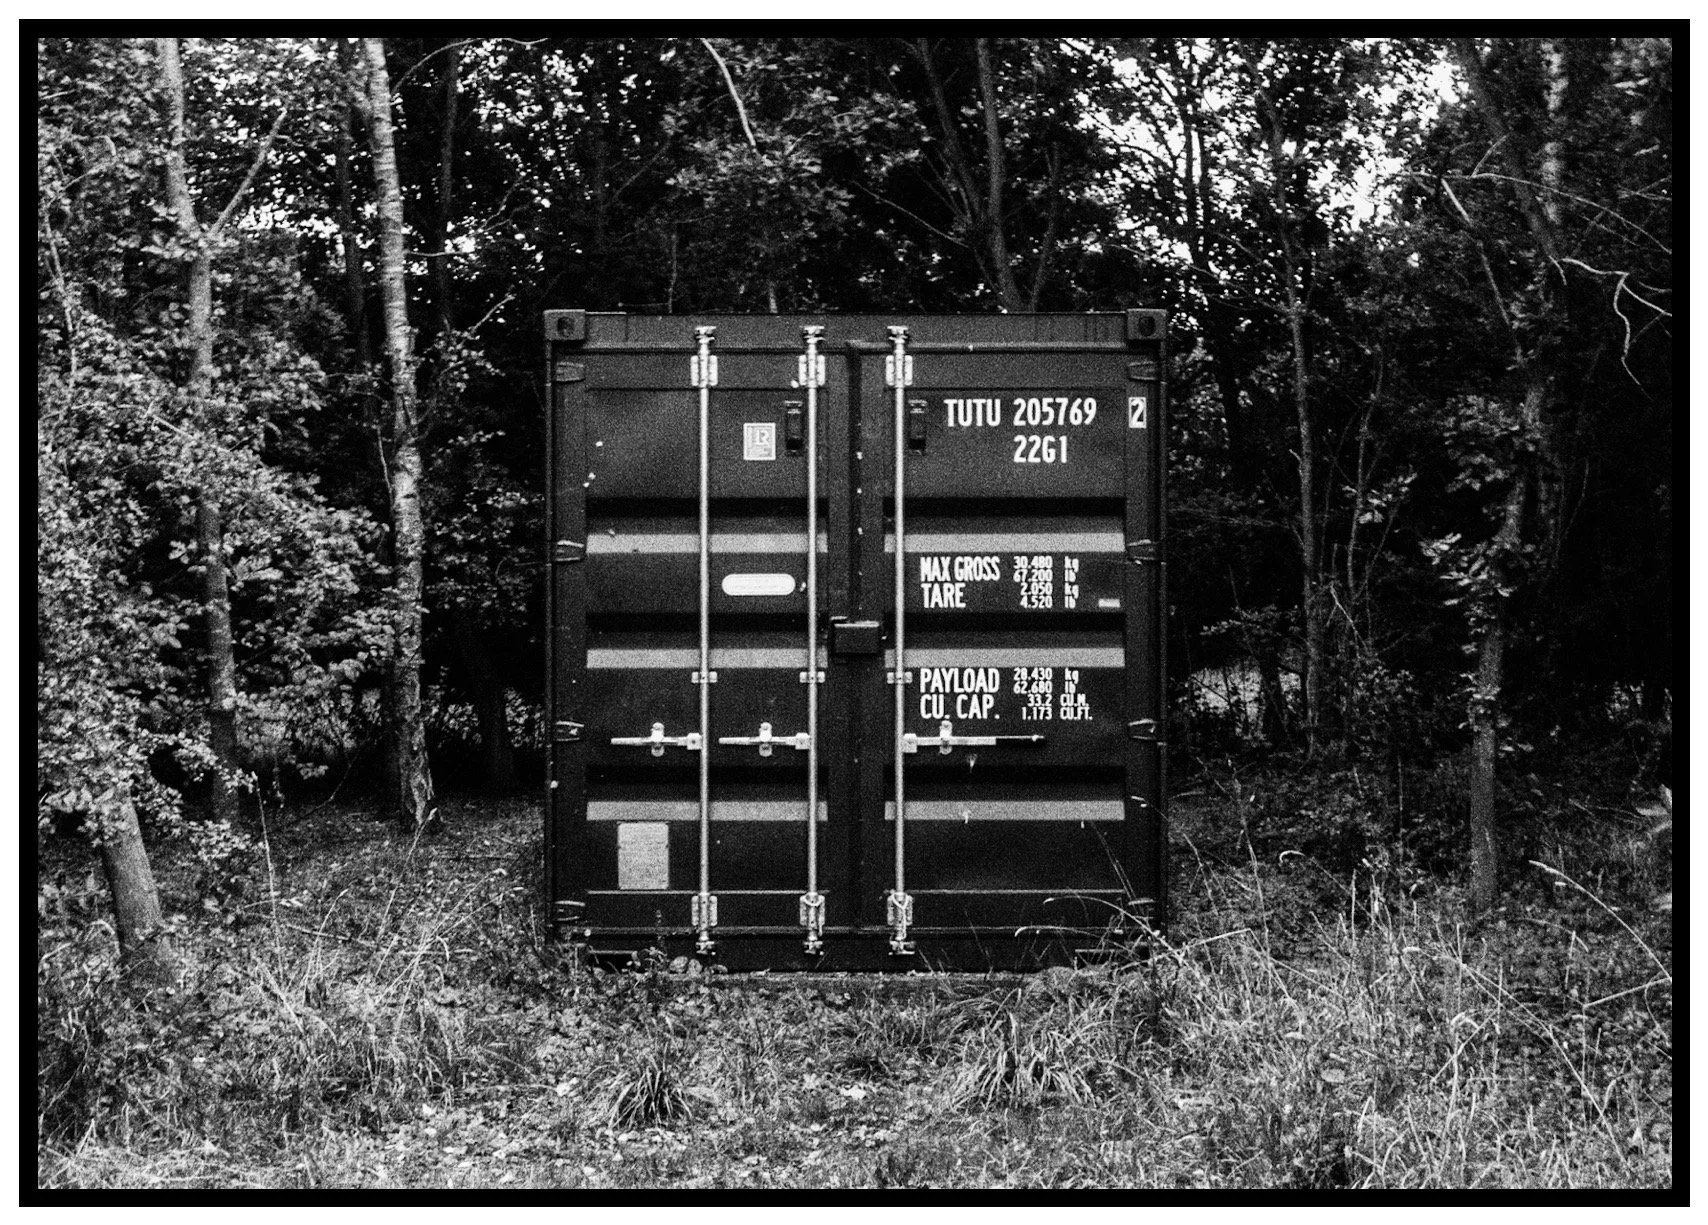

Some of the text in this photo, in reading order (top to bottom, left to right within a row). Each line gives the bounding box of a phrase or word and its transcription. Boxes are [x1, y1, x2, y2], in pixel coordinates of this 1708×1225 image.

[944, 397, 1145, 427] TUTU 205769 2
[1013, 435, 1067, 463] 22G1
[920, 556, 1000, 582] MAX GROSS
[1013, 556, 1079, 573] 30.480 kg
[1013, 569, 1076, 582] 67.200 lb
[921, 583, 966, 608] TARE
[1020, 582, 1079, 599] 2.050 kg
[1020, 595, 1076, 608] 4.520 lb
[920, 668, 1000, 693] PAYLOAD
[1013, 667, 1079, 684] 28.430 kg
[1013, 681, 1076, 694] 62.680 lb
[920, 694, 1000, 719] CU. CAP.
[1027, 694, 1089, 707] 33.2 CU.M.
[1022, 707, 1093, 720] 1.173 CU.FT.
